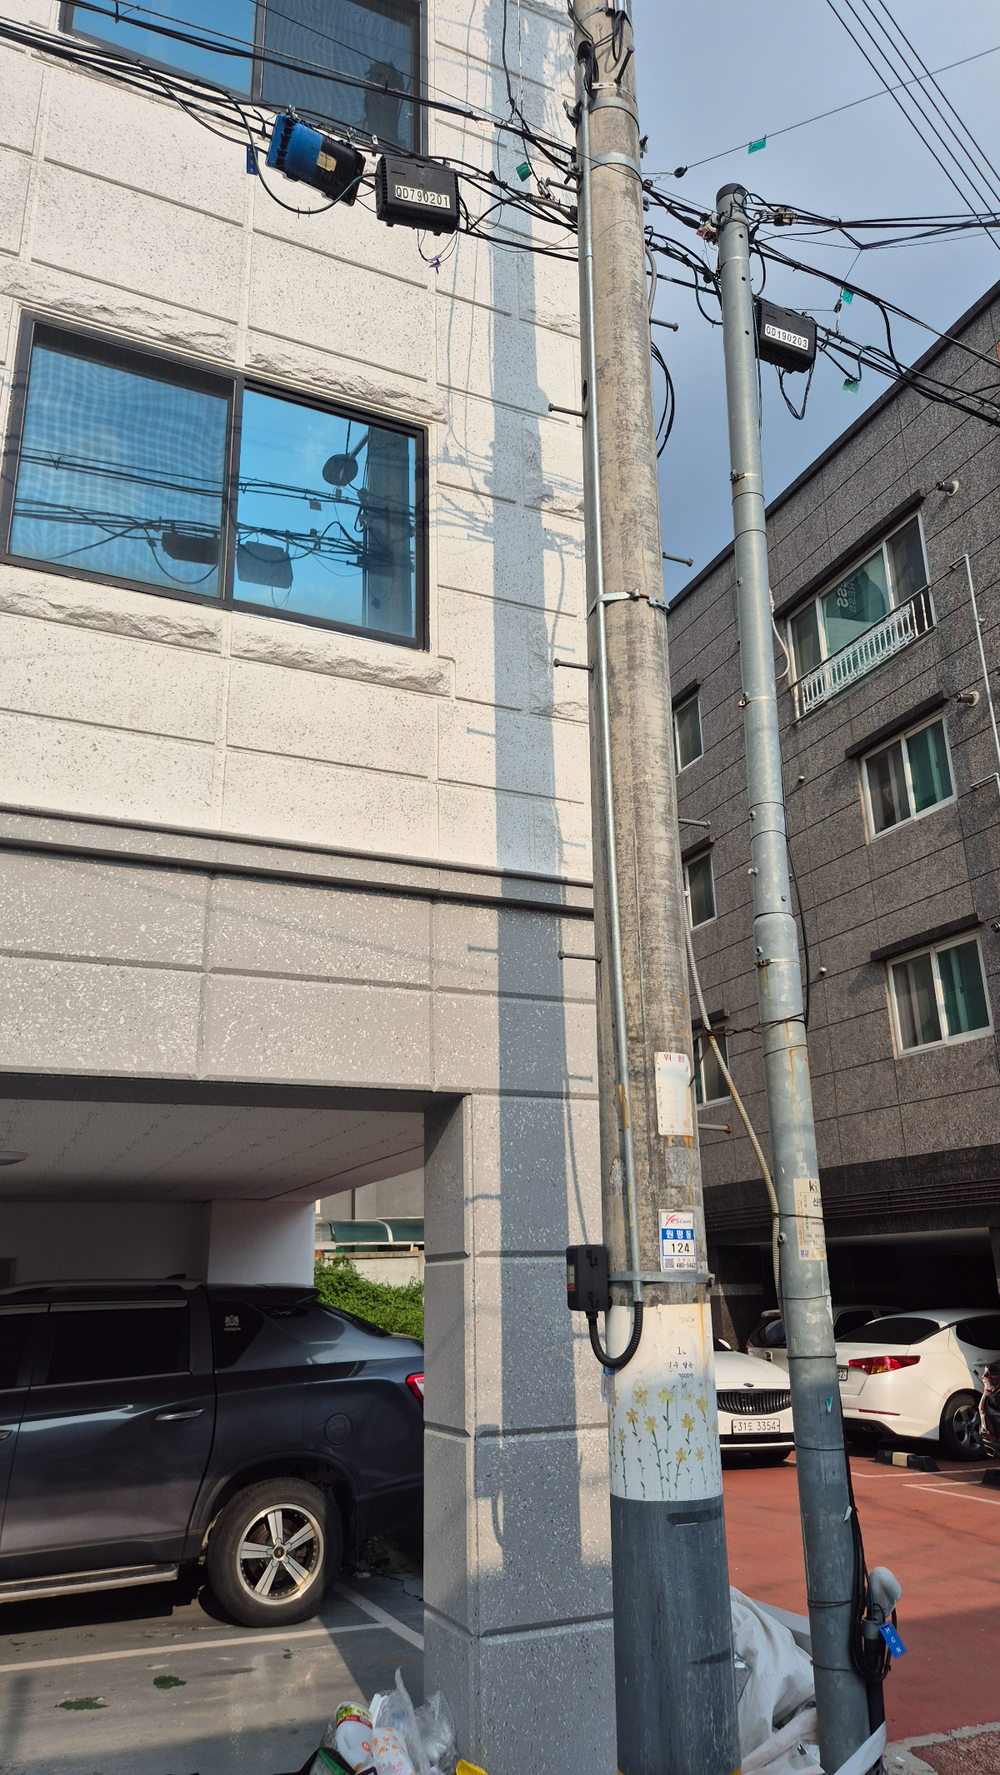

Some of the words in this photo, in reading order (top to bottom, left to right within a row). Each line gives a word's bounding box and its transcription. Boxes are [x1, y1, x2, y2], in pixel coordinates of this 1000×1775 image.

[396, 186, 449, 207] QD790201
[766, 325, 808, 348] QD190203
[671, 1242, 690, 1254] 124
[756, 1421, 776, 1432] 3354
